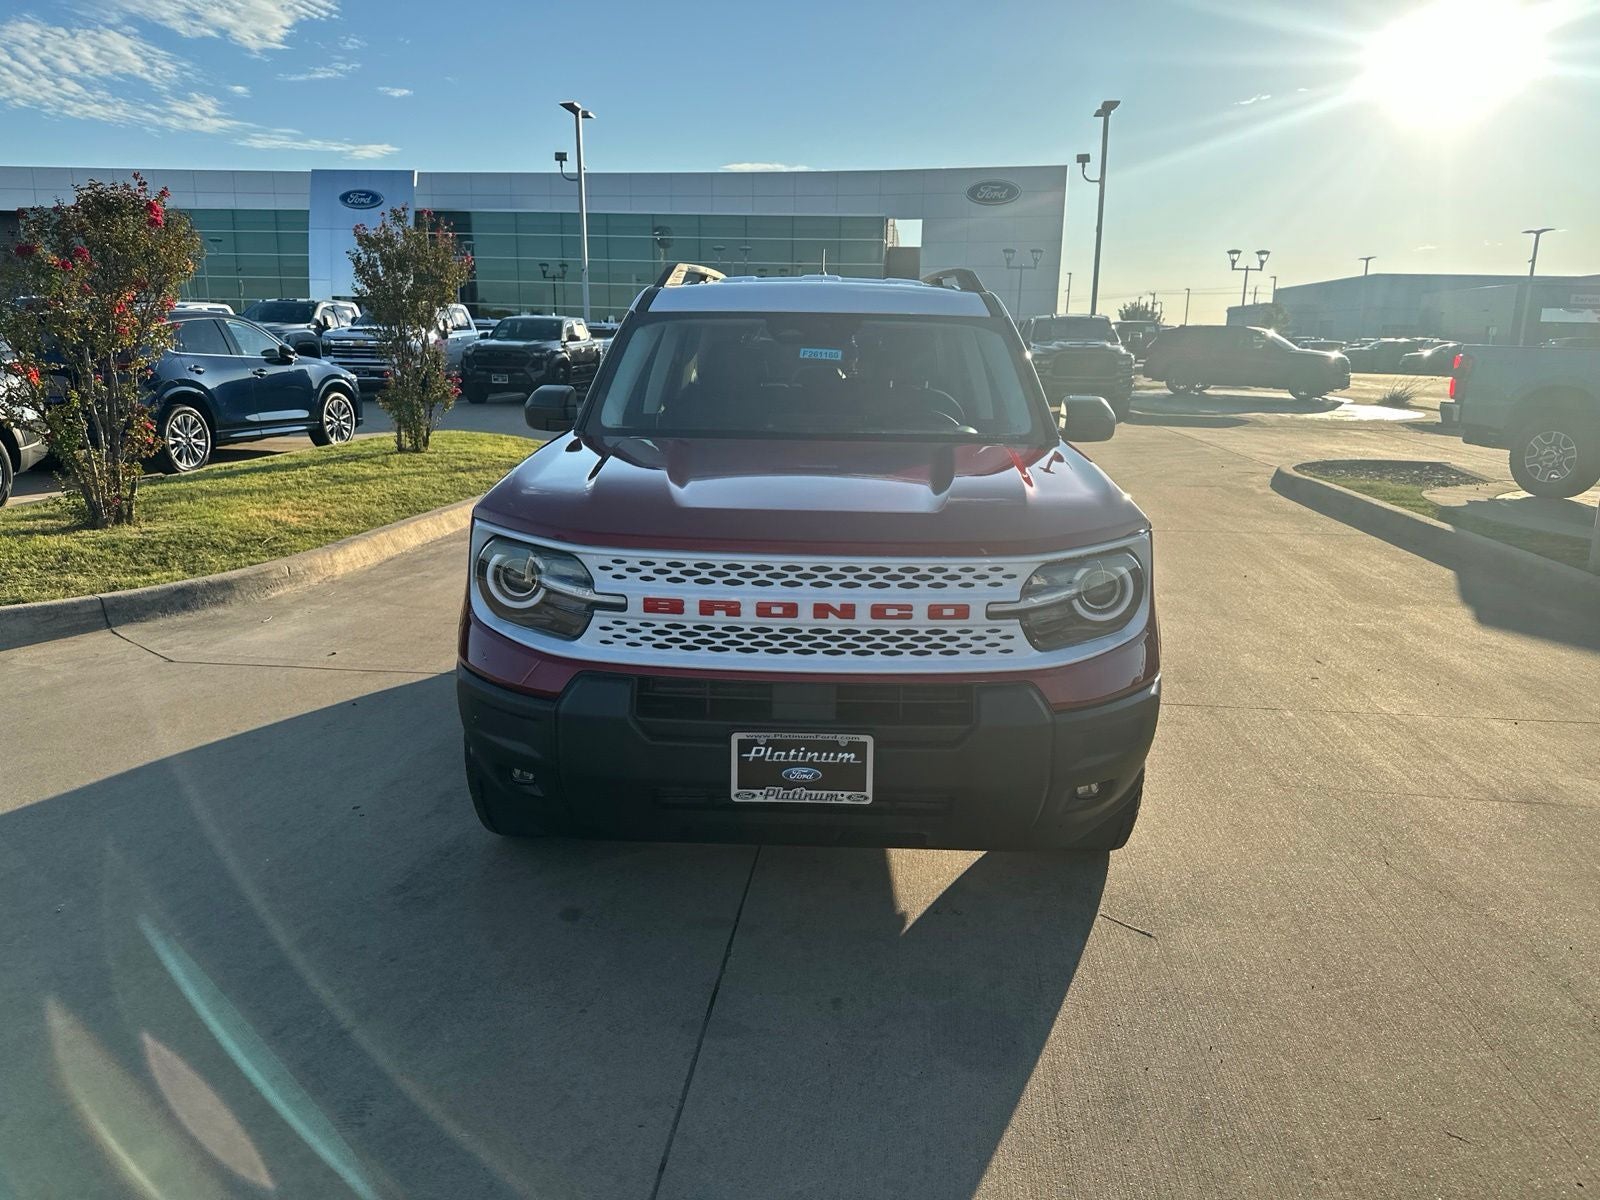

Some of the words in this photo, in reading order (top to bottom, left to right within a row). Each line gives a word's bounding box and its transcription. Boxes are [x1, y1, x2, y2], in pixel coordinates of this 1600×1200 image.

[347, 192, 372, 203] Ford
[976, 185, 1008, 199] Ford
[643, 597, 970, 620] BRONCO
[745, 733, 860, 741] www.PlatinumFord.com
[741, 746, 863, 763] Platinum
[789, 769, 815, 780] Ford
[764, 787, 845, 802] Platinum
